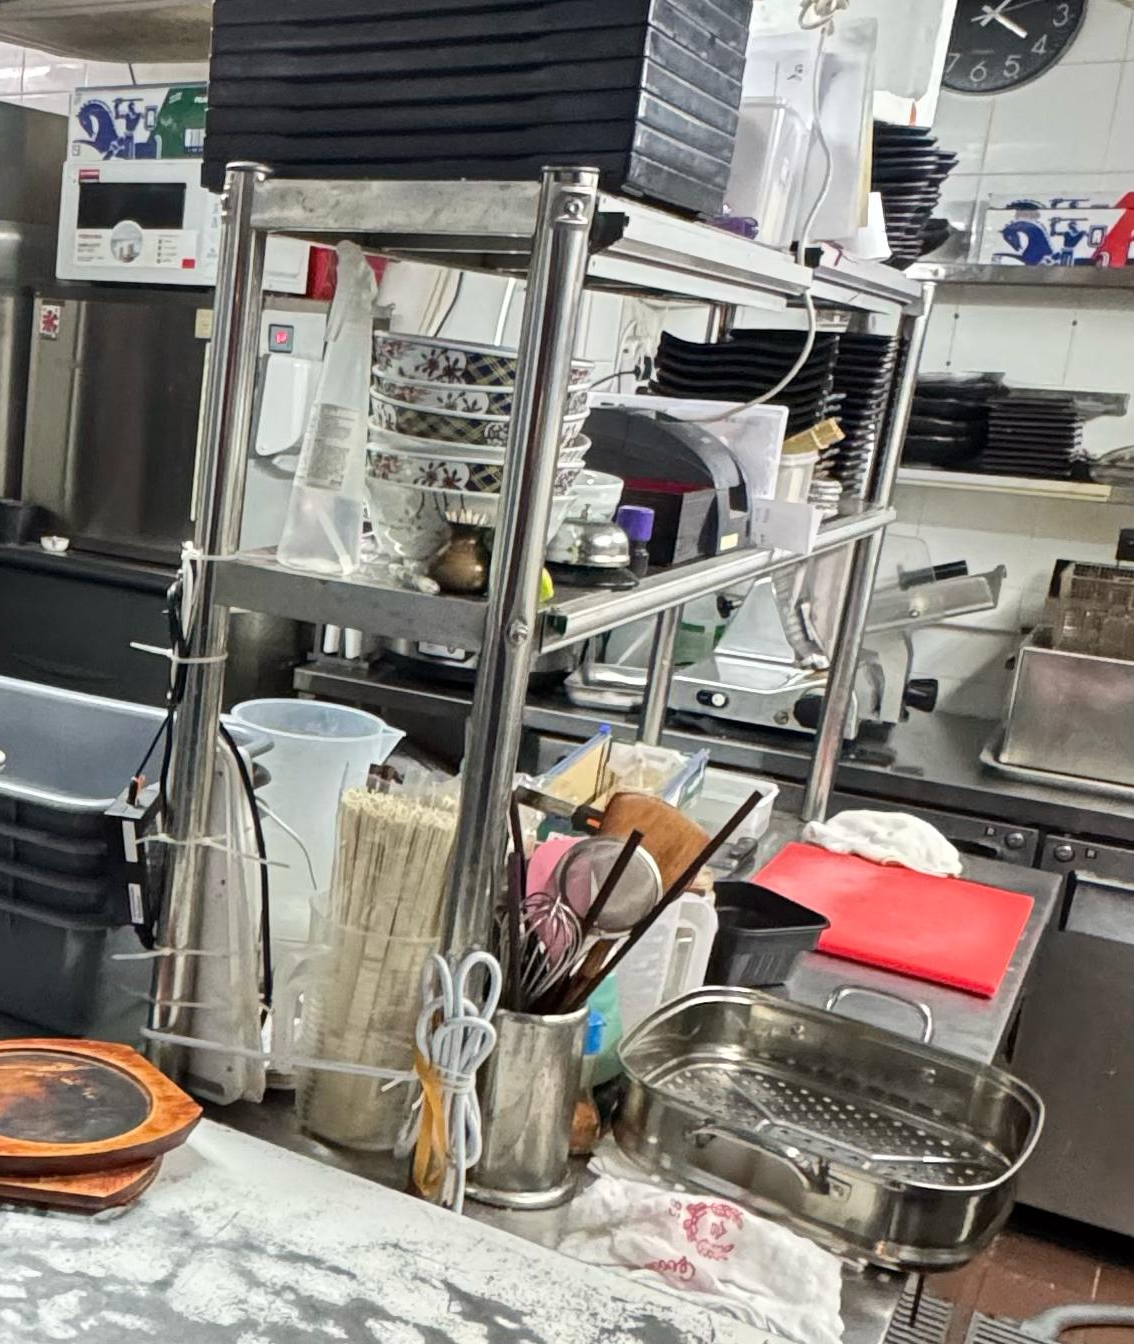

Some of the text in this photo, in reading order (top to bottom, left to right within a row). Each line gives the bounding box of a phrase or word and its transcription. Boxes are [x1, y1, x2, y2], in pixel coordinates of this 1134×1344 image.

[1052, 2, 1070, 28] 3
[1031, 33, 1049, 55] 4
[969, 60, 988, 83] 6
[1003, 54, 1022, 78] 5
